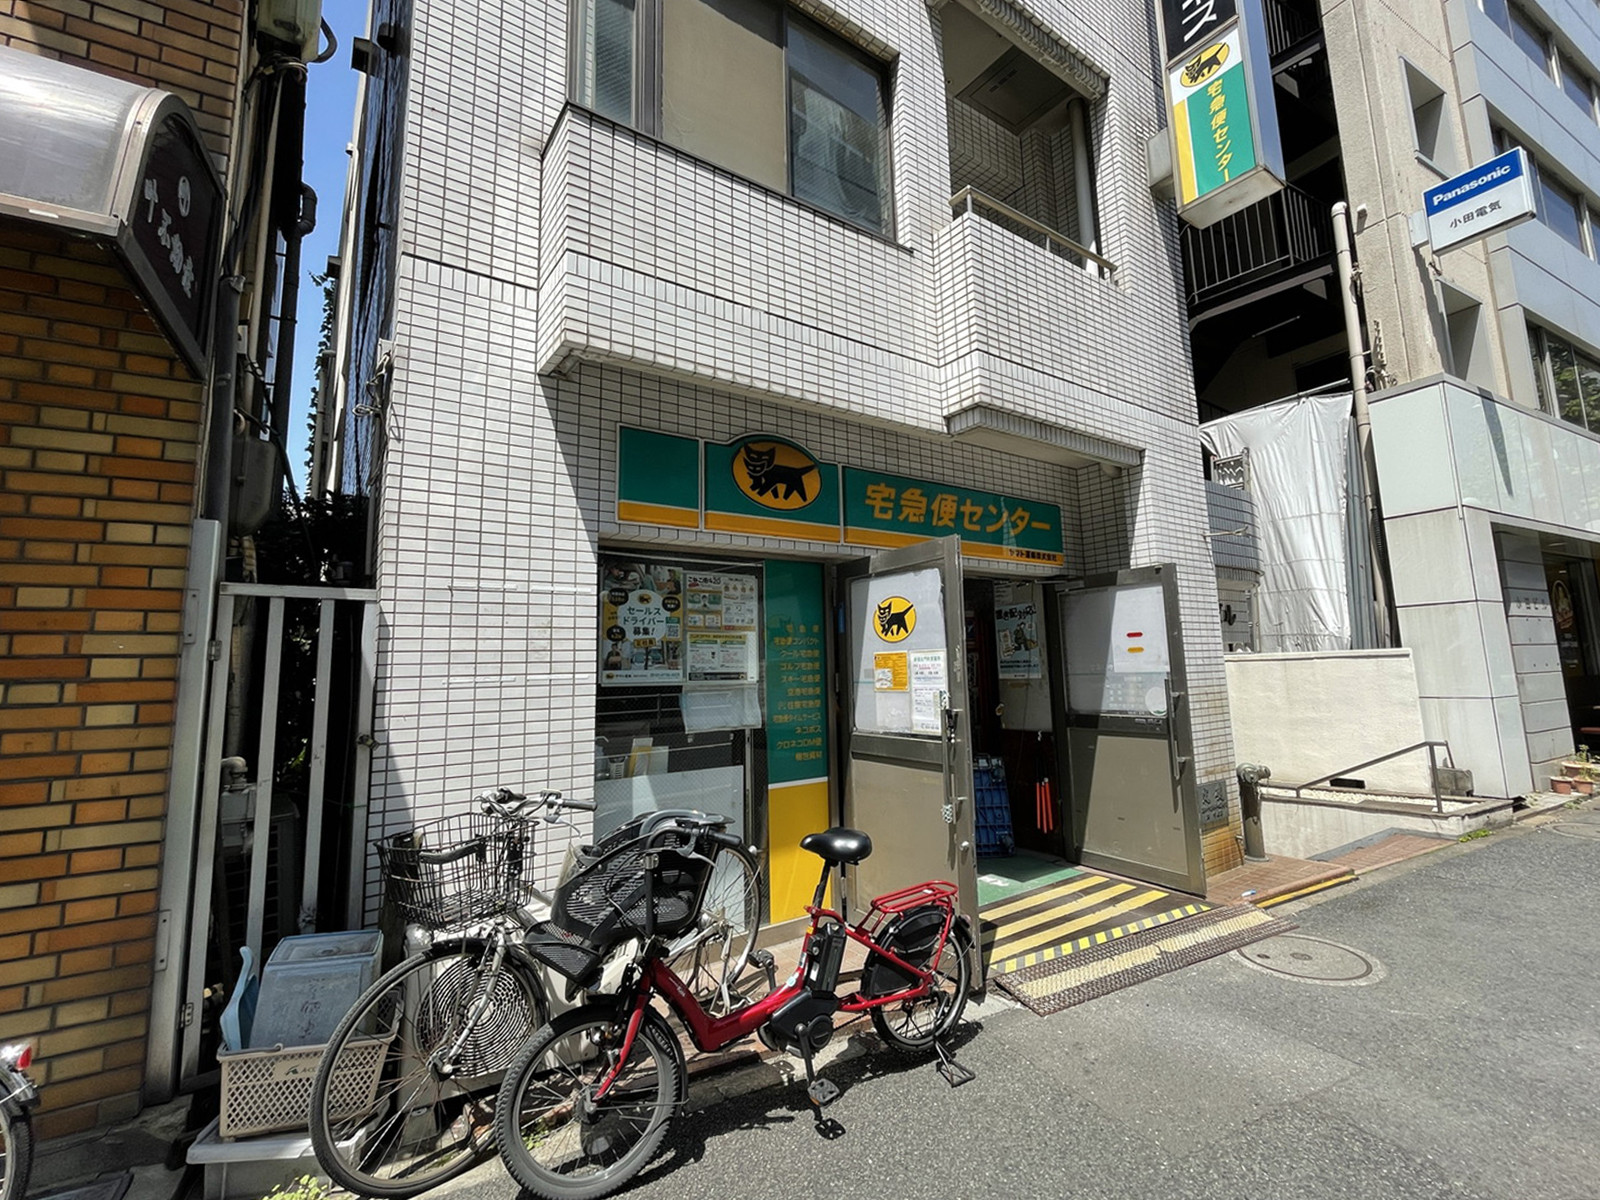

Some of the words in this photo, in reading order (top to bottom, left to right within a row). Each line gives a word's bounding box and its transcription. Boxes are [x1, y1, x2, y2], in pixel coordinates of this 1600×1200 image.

[1206, 78, 1234, 182] 宅急便センター
[1432, 163, 1511, 206] Panasonic
[1449, 200, 1502, 229] 小田電気
[866, 484, 1052, 534] 宅急便センター
[623, 616, 664, 626] ドライバー
[627, 606, 661, 615] セールス
